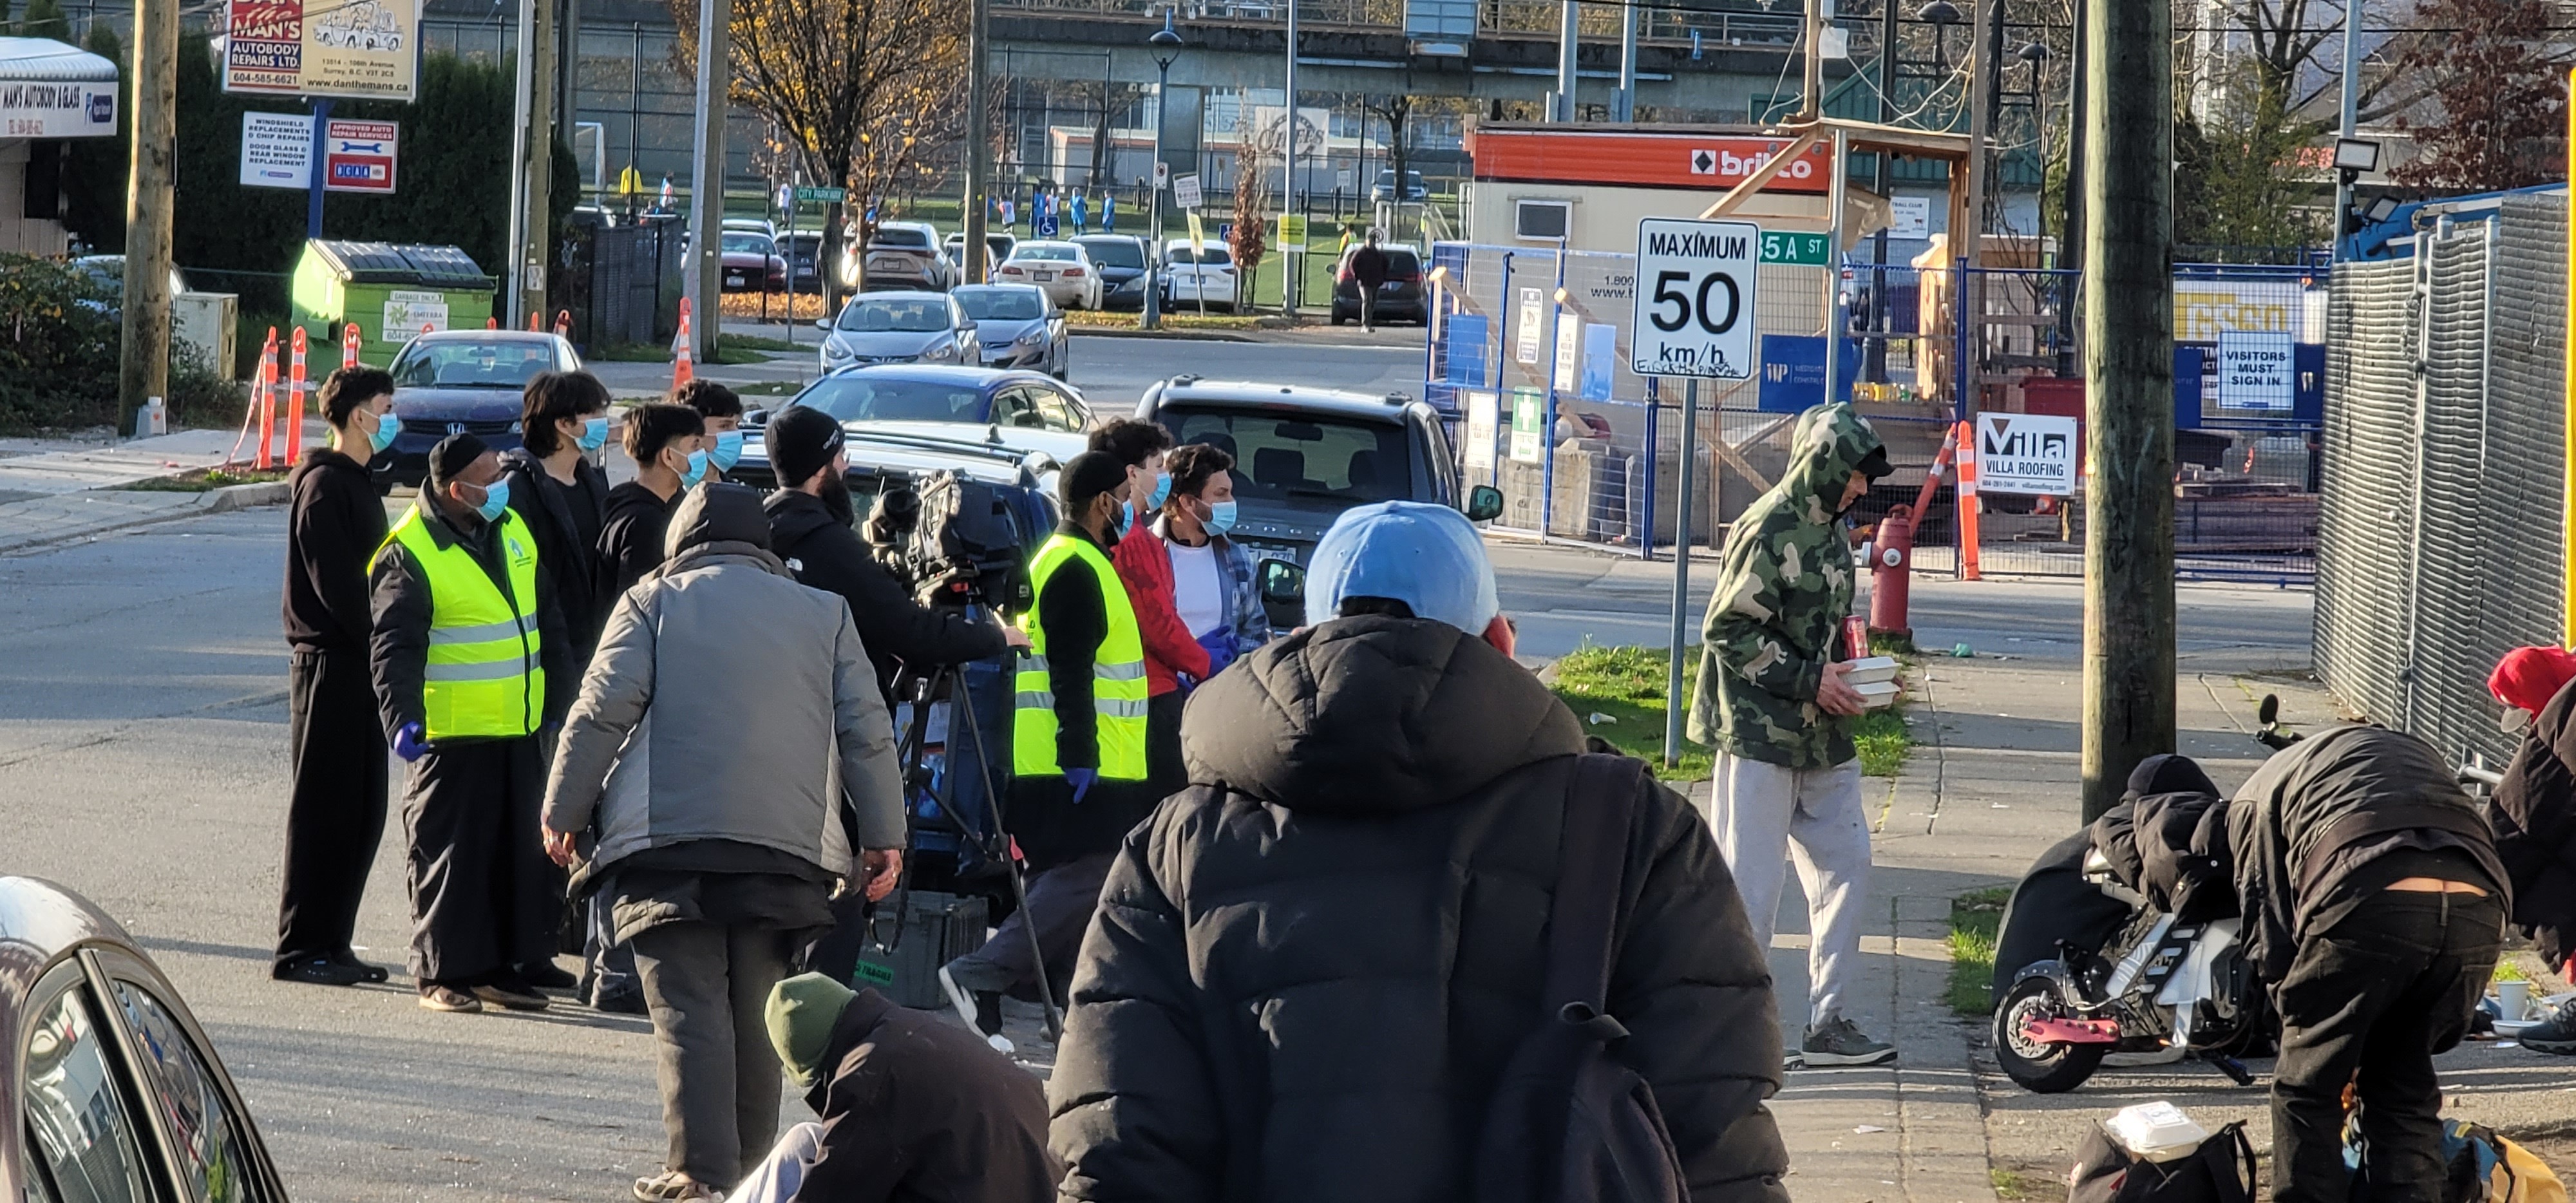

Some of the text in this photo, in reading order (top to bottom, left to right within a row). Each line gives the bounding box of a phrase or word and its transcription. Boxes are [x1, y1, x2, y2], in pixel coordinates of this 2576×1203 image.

[233, 18, 300, 39] MAN'S
[232, 43, 299, 55] AUTOBODY
[231, 53, 299, 67] REPAIRS LTD.
[234, 73, 297, 84] 604-585-6621
[307, 79, 408, 91] www.danthemans.ca
[24, 85, 56, 109] AUTOBODY
[63, 86, 80, 108] GLASS
[249, 126, 310, 135] REPLACEMENTS
[249, 158, 305, 166] REPLACEMENT
[337, 166, 368, 176] BCAA
[1649, 232, 1746, 260] MAXIMUM
[1808, 239, 1822, 254] ST
[1649, 270, 1740, 334] 50
[1660, 341, 1724, 366] km/h
[2226, 351, 2286, 361] VISITORS
[2238, 364, 2275, 374] MUST
[2231, 376, 2280, 386] SIGN IN
[1986, 460, 2064, 477] VILLA ROOFING
